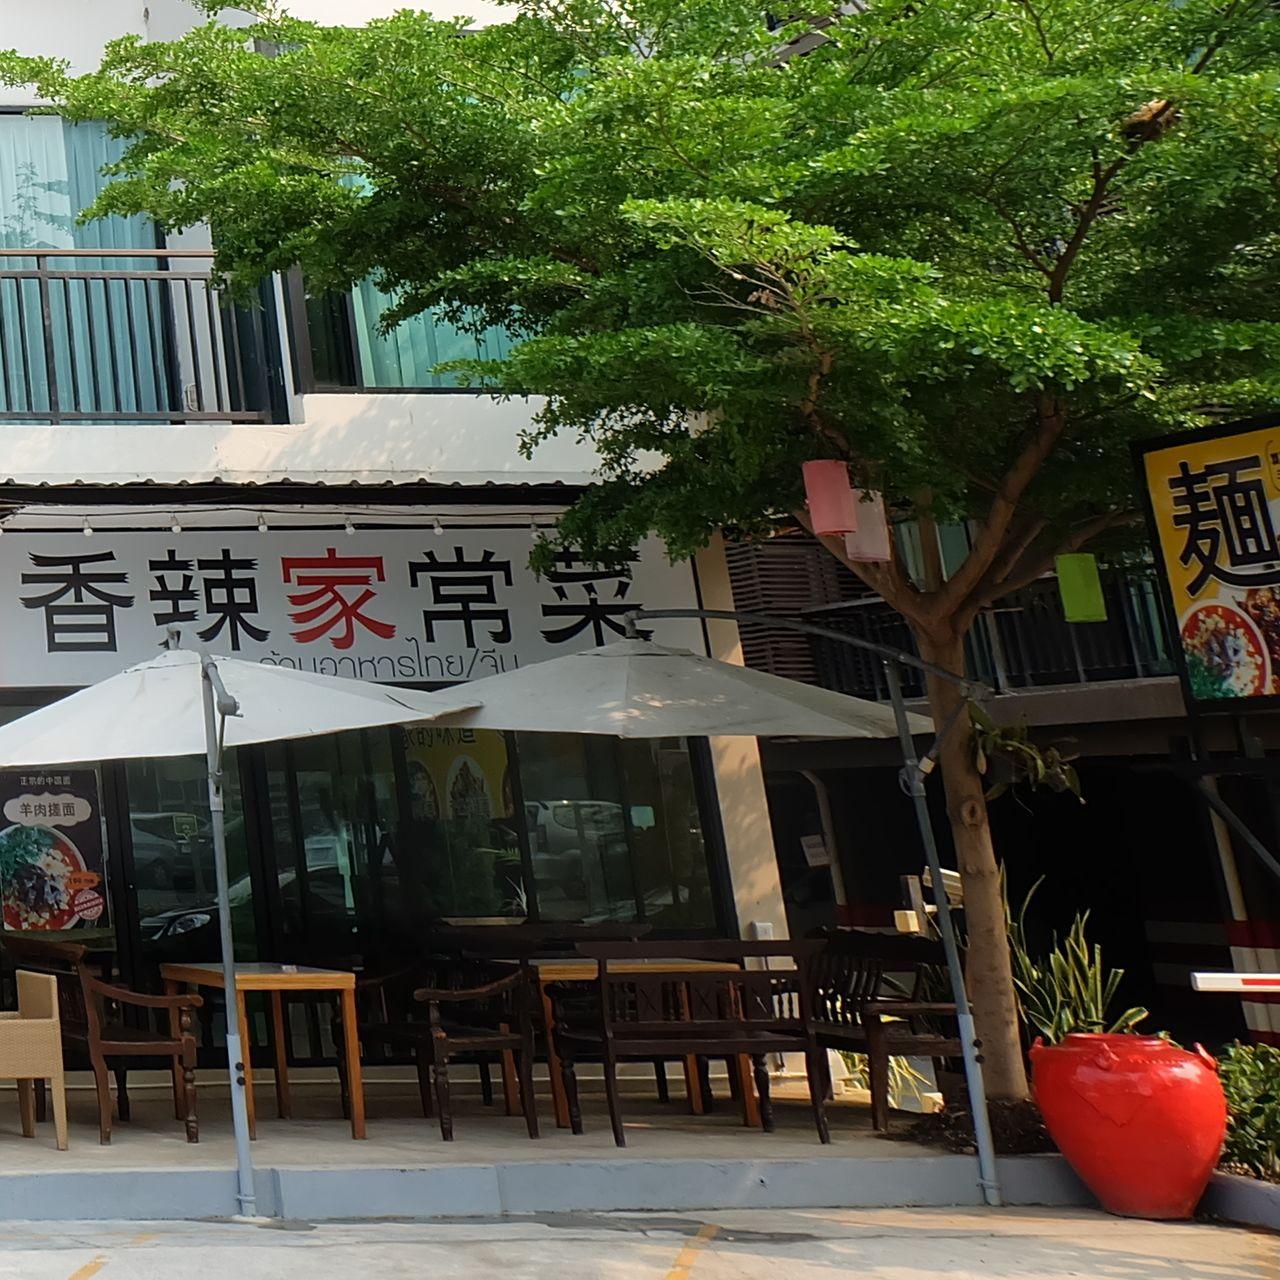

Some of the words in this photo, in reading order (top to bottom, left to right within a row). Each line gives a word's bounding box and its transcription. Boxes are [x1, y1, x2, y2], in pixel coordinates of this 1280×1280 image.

[19, 546, 655, 653] 香辣家常菜
